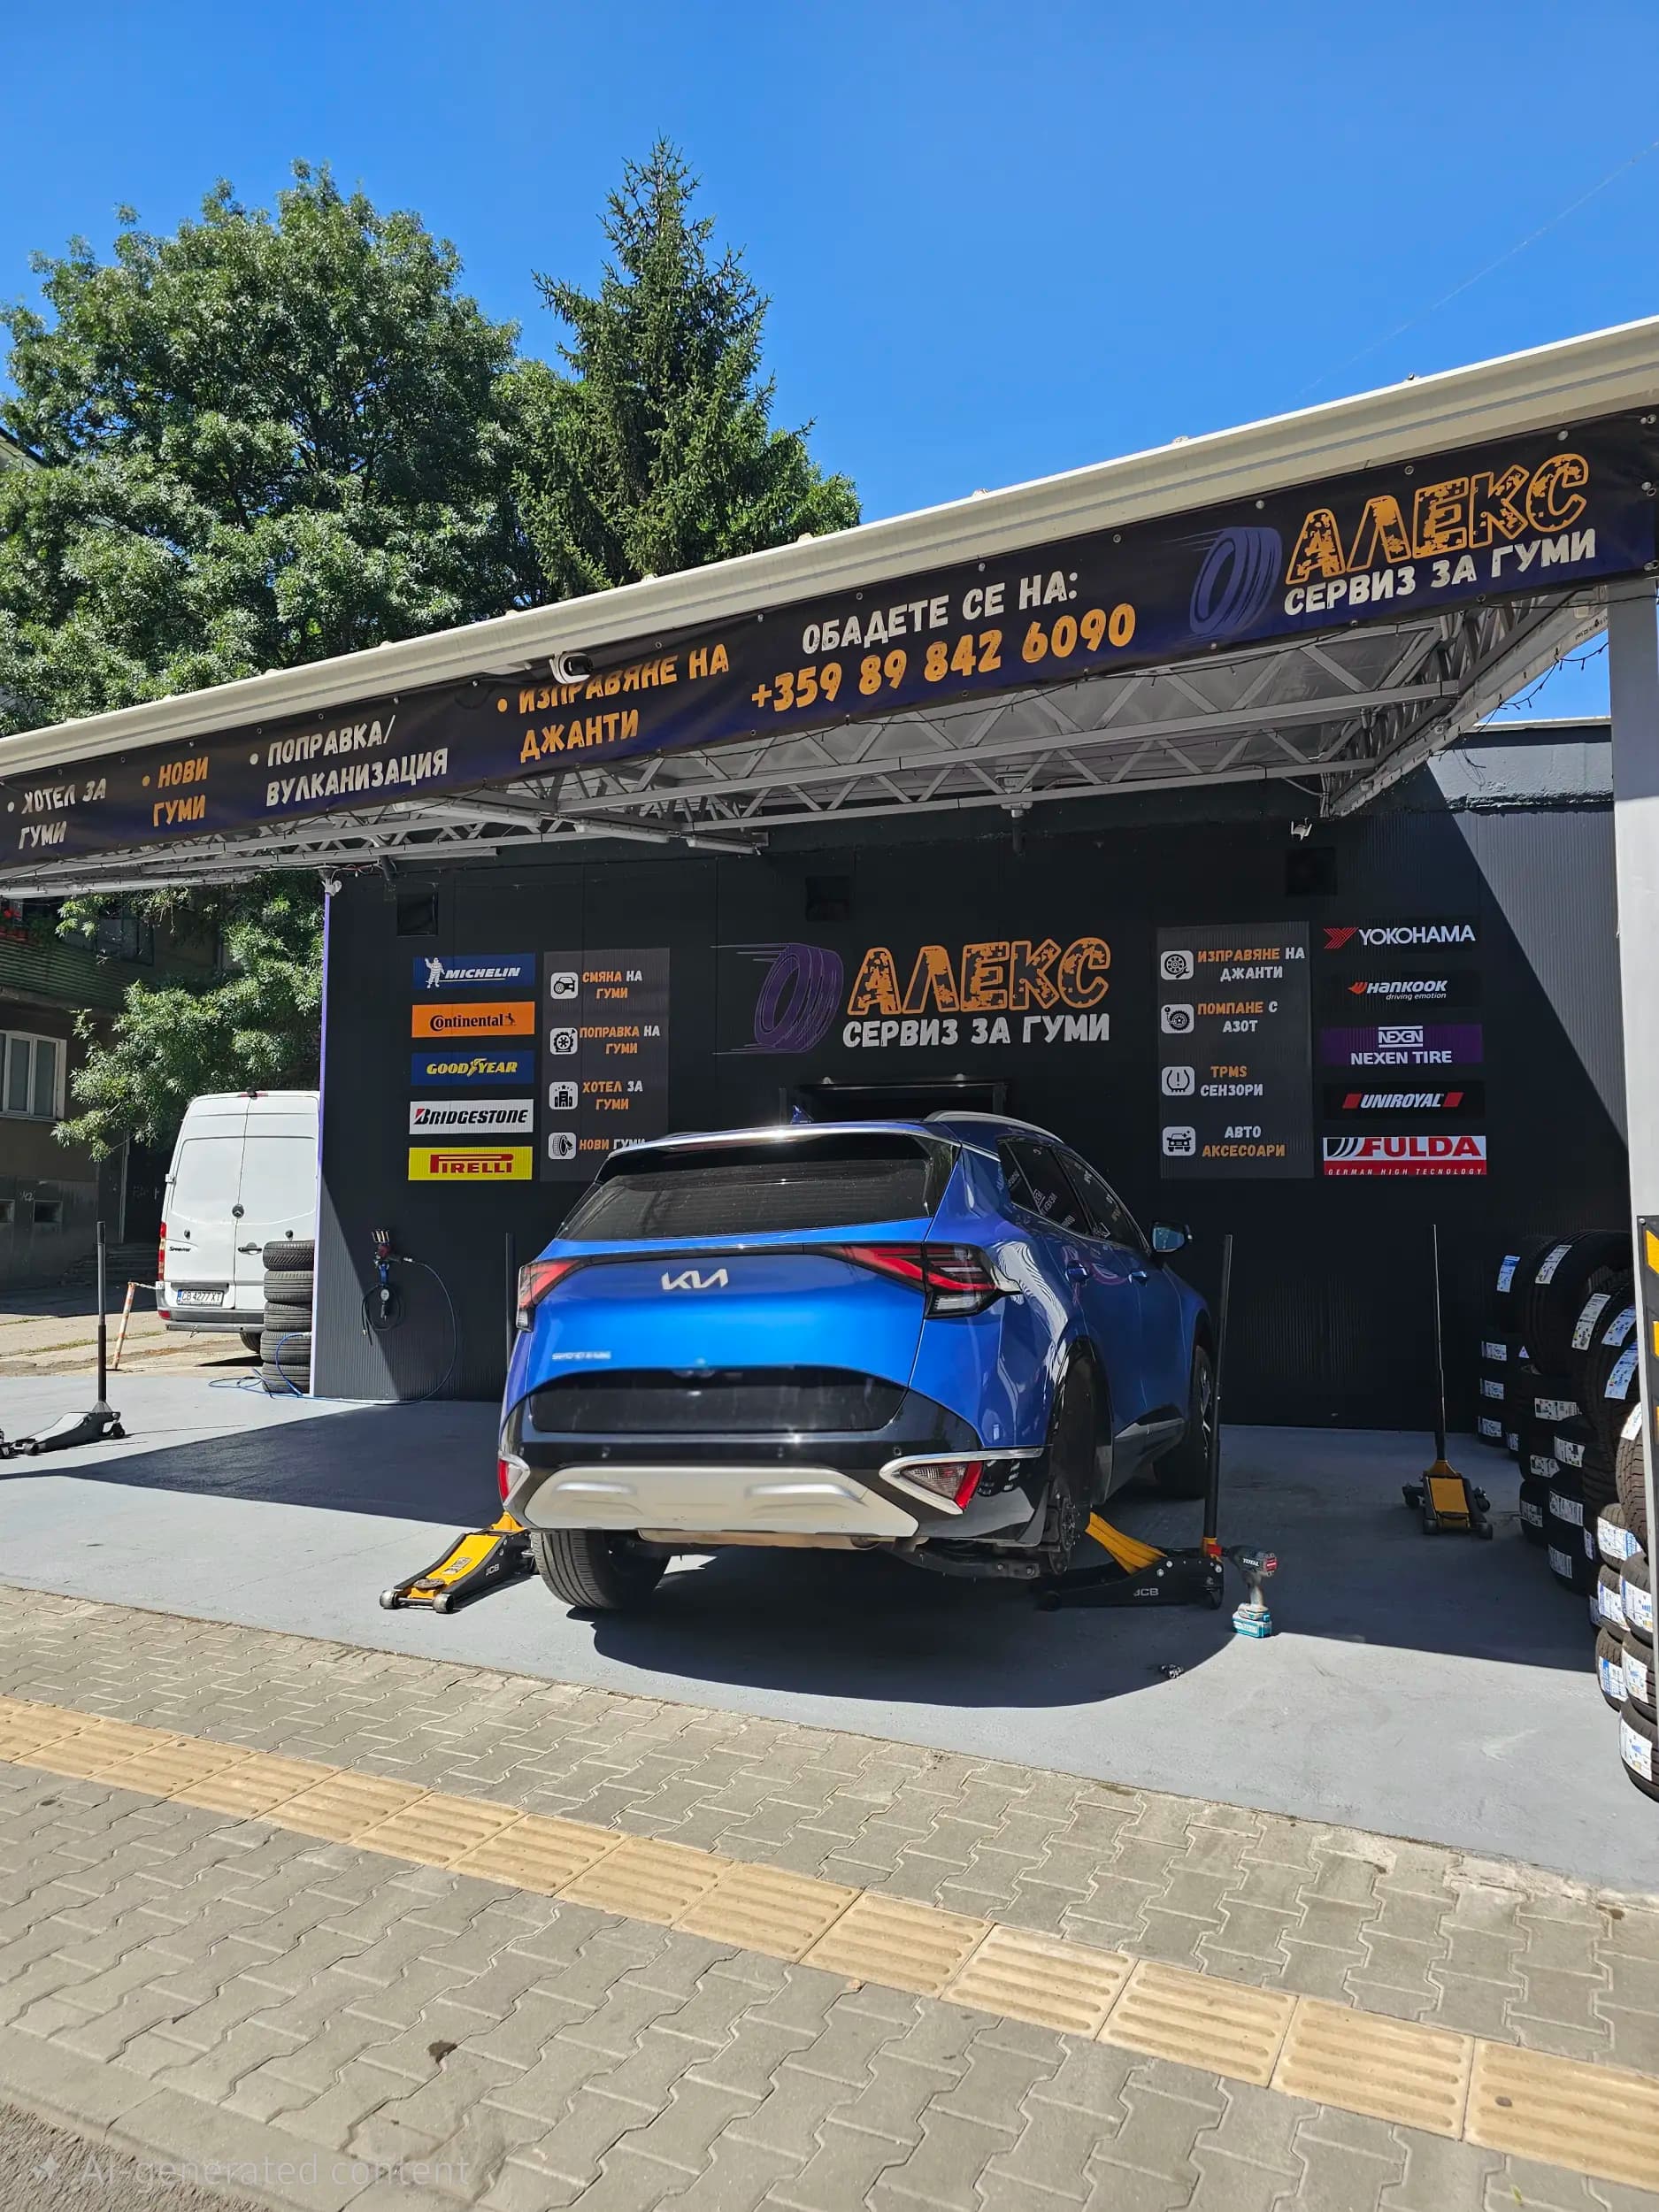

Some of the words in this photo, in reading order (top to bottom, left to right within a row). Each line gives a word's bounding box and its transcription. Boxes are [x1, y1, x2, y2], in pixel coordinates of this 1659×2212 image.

[1285, 453, 1590, 585] АЛЕКС
[1284, 566, 1416, 617] СЕРВИЗ
[1430, 554, 1477, 588] ЗА
[1491, 528, 1595, 579] ГУМИ
[803, 595, 949, 655] ОБАДЕТЕ
[962, 588, 1004, 622] СЕ
[1018, 572, 1079, 611] НА:
[688, 643, 729, 680] НА
[751, 664, 841, 712] +359
[858, 649, 906, 696] 89
[924, 629, 1004, 685] 842
[1021, 603, 1137, 664] 6090
[268, 715, 396, 767] ПОПРАВКА/
[520, 710, 639, 764] ДЖАНТИ
[157, 757, 209, 788] НОВИ
[266, 749, 449, 807] ВУЛКАНИЗАЦИЯ
[22, 785, 74, 814] ХОТЕЛ
[82, 778, 106, 803] ЗА
[153, 795, 205, 827] ГУМИ
[19, 821, 66, 849] ГУМИ
[1359, 925, 1476, 946] YOKOHAMA
[1197, 948, 1280, 963] ИЗПРАВЯНЕ
[1286, 947, 1305, 960] НА
[445, 967, 520, 979] MICHELIN
[582, 972, 622, 983] СМЯНА
[626, 971, 642, 981] НА
[847, 937, 1111, 1016] АЛЕКС
[1220, 966, 1283, 982] ДЖАНТИ
[596, 987, 628, 999] ГУМИ
[1197, 1002, 1263, 1016] ПОМПАНЕ
[430, 1014, 503, 1032] Continental
[580, 1026, 639, 1038] ПОПРАВКА
[644, 1025, 660, 1037] НА
[842, 1018, 958, 1048] СЕРВИЗ
[971, 1017, 1010, 1044] ЗА
[1022, 1013, 1110, 1043] ГУМИ
[1223, 1019, 1257, 1033] АЗОТ
[1378, 1028, 1424, 1047] NEXEN
[605, 1043, 637, 1054] ГУМИ
[1351, 1051, 1409, 1065] NEXEN
[1412, 1050, 1453, 1064] TIRE
[1210, 1065, 1248, 1078] TPMS
[582, 1081, 622, 1093] ХОТЕЛ
[627, 1080, 643, 1092] ЗА
[1200, 1084, 1263, 1097] СЕНЗОРИ
[595, 1099, 629, 1110] ГУМИ
[1360, 1093, 1441, 1108] UNIROYAL
[414, 1108, 528, 1125] BRIDGESTONE
[1225, 1125, 1262, 1139] АВТО
[580, 1139, 610, 1150] НОВИ
[1202, 1144, 1286, 1158] АКСЕСОАРИ
[1356, 1136, 1482, 1157] FULDA
[430, 1154, 514, 1173] PIRELLI
[662, 1268, 728, 1290] KIA
[486, 1563, 500, 1576] JCB
[1133, 1587, 1159, 1597] JCB
